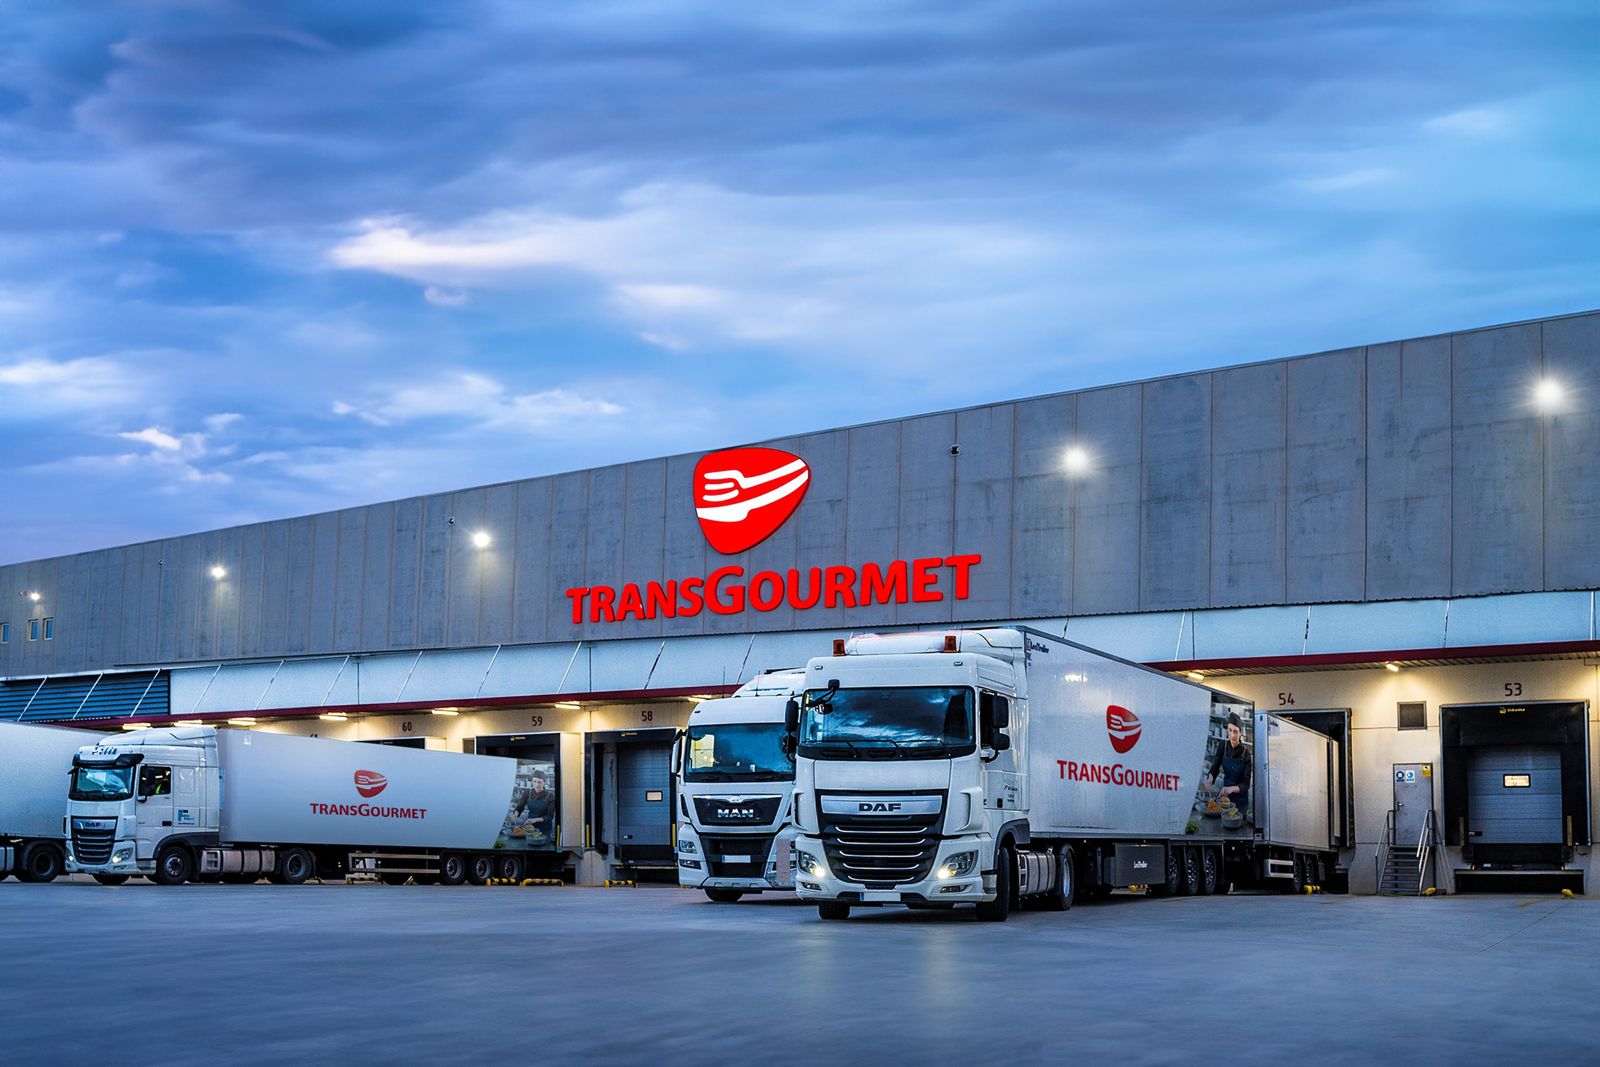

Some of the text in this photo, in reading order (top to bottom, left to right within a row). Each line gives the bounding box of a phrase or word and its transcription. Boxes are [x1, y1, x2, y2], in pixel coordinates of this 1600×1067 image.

[566, 555, 981, 623] TRANSGOURMET
[1504, 682, 1522, 697] 53
[1278, 692, 1295, 706] 54
[532, 715, 543, 727] 59
[641, 710, 654, 722] 58
[402, 721, 412, 732] 60
[1056, 759, 1180, 791] TRANSGOURMET
[310, 803, 427, 819] TRANSGOURMET
[717, 808, 754, 818] MAN
[858, 803, 901, 812] DAF
